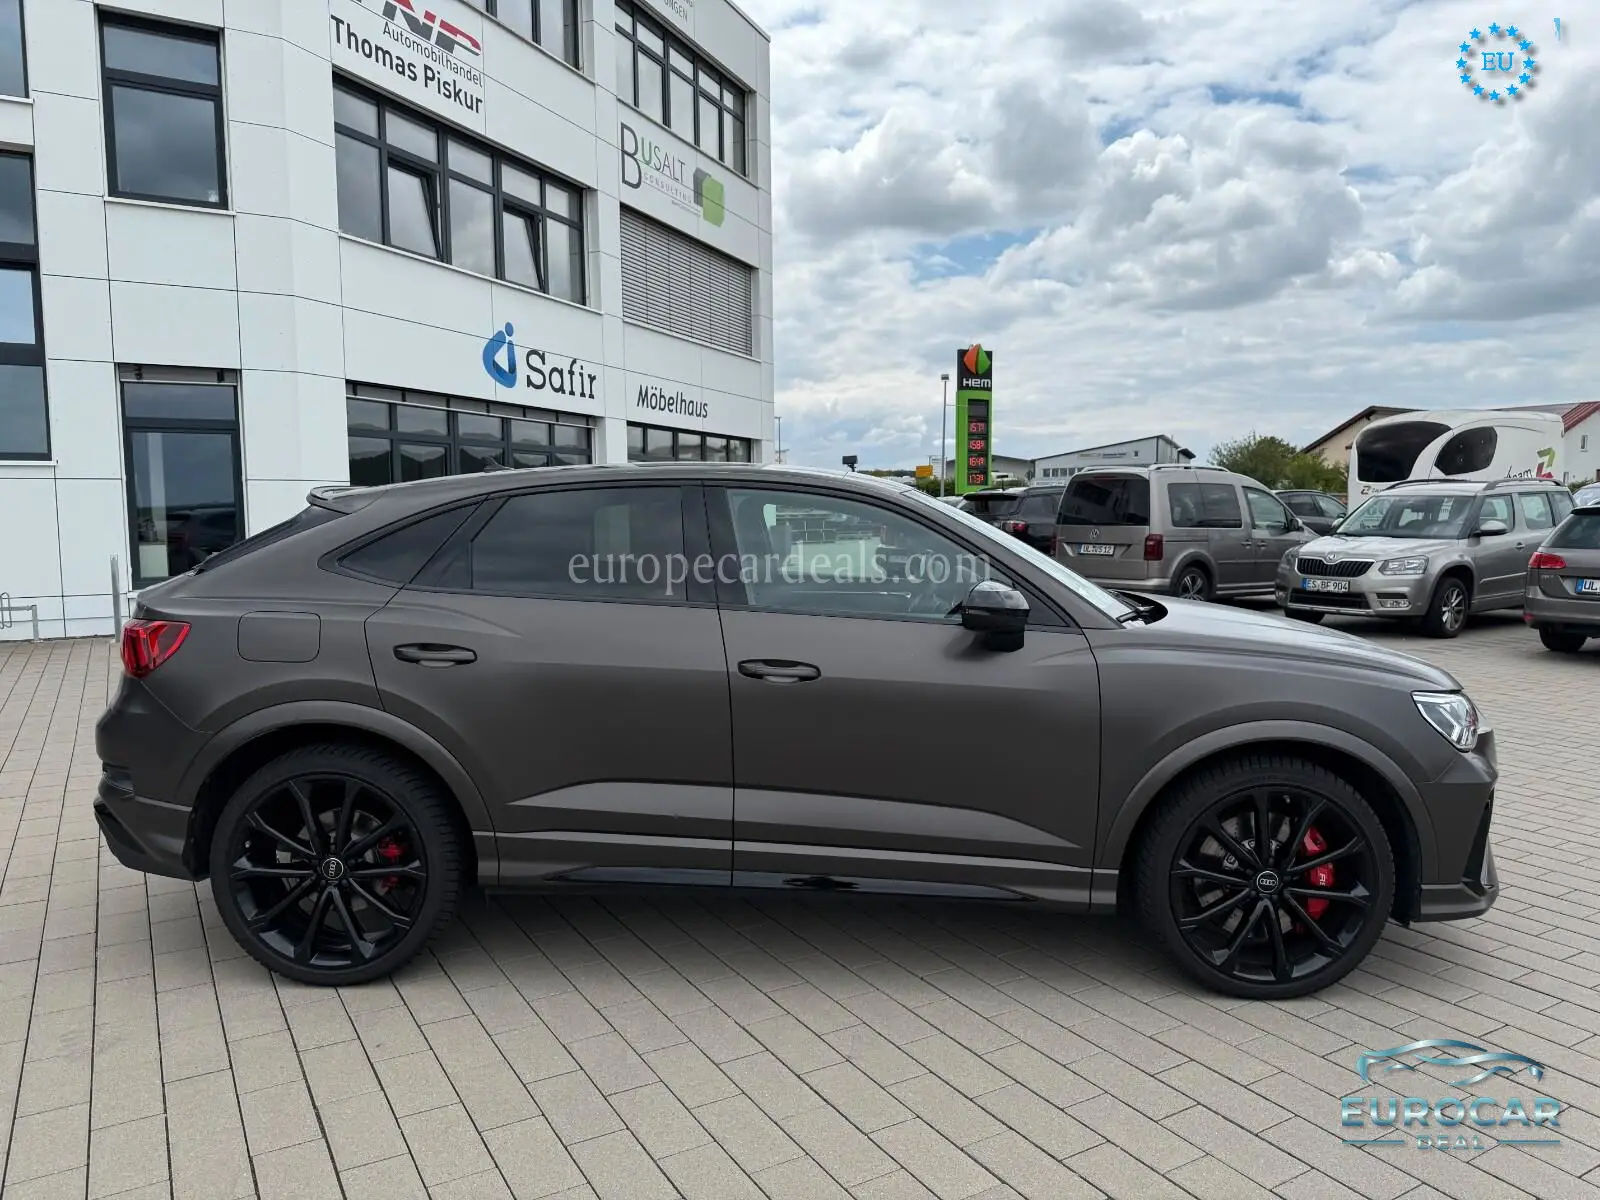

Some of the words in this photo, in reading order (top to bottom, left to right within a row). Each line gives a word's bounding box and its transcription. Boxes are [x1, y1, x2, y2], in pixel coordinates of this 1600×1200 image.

[330, 14, 418, 82] Thomas
[423, 63, 483, 114] Piskur
[382, 21, 483, 88] Automobilhandel
[620, 121, 686, 190] BUSALT
[525, 349, 597, 400] Safir
[636, 384, 709, 420] Möbelhaus
[1583, 580, 1598, 591] UL
